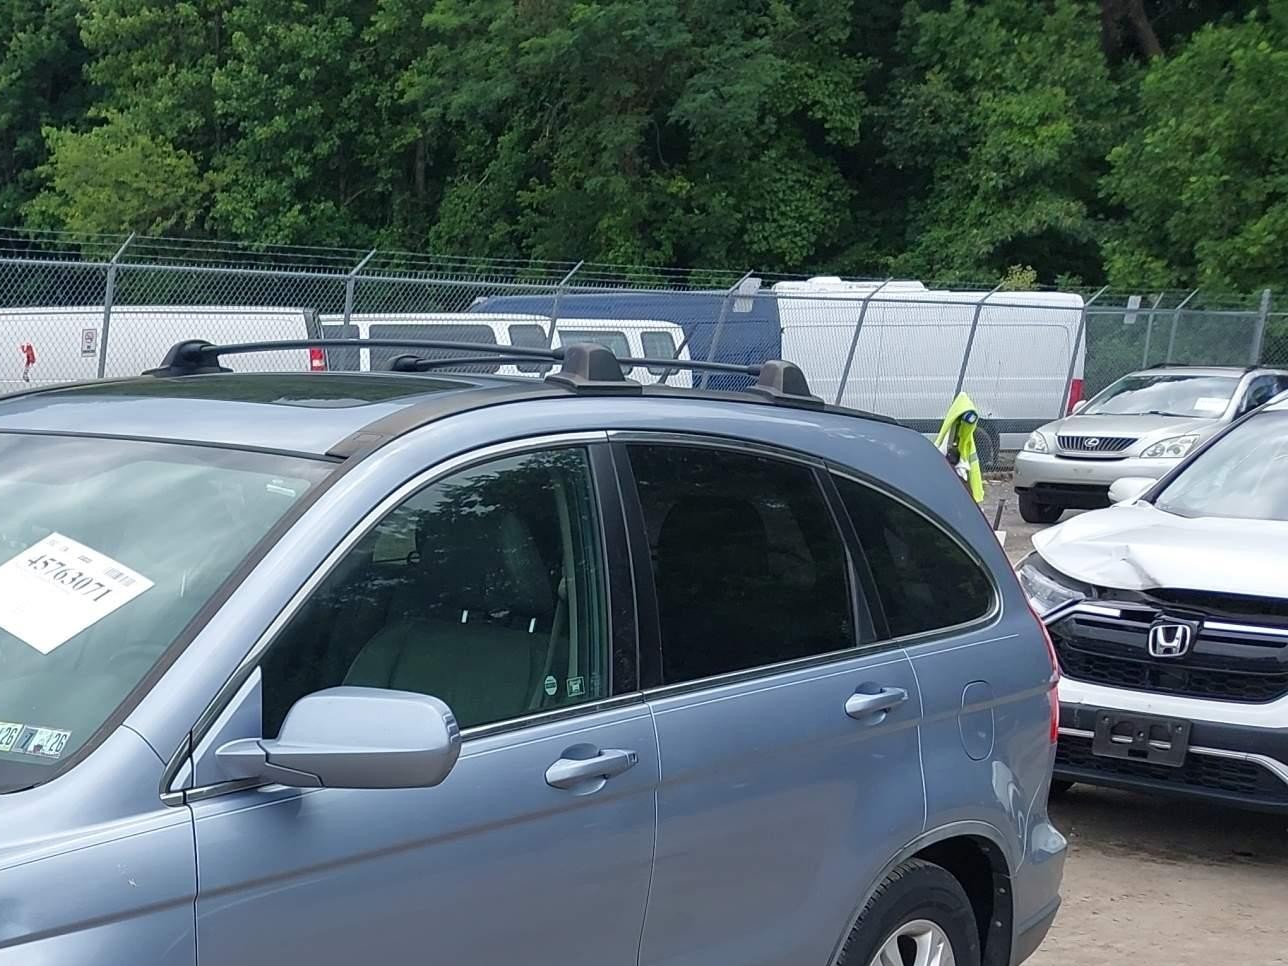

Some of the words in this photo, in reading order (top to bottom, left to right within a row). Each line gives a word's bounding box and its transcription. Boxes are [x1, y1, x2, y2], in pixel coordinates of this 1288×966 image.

[27, 554, 113, 602] 45763071
[0, 727, 18, 746] 26
[48, 733, 68, 753] 26
